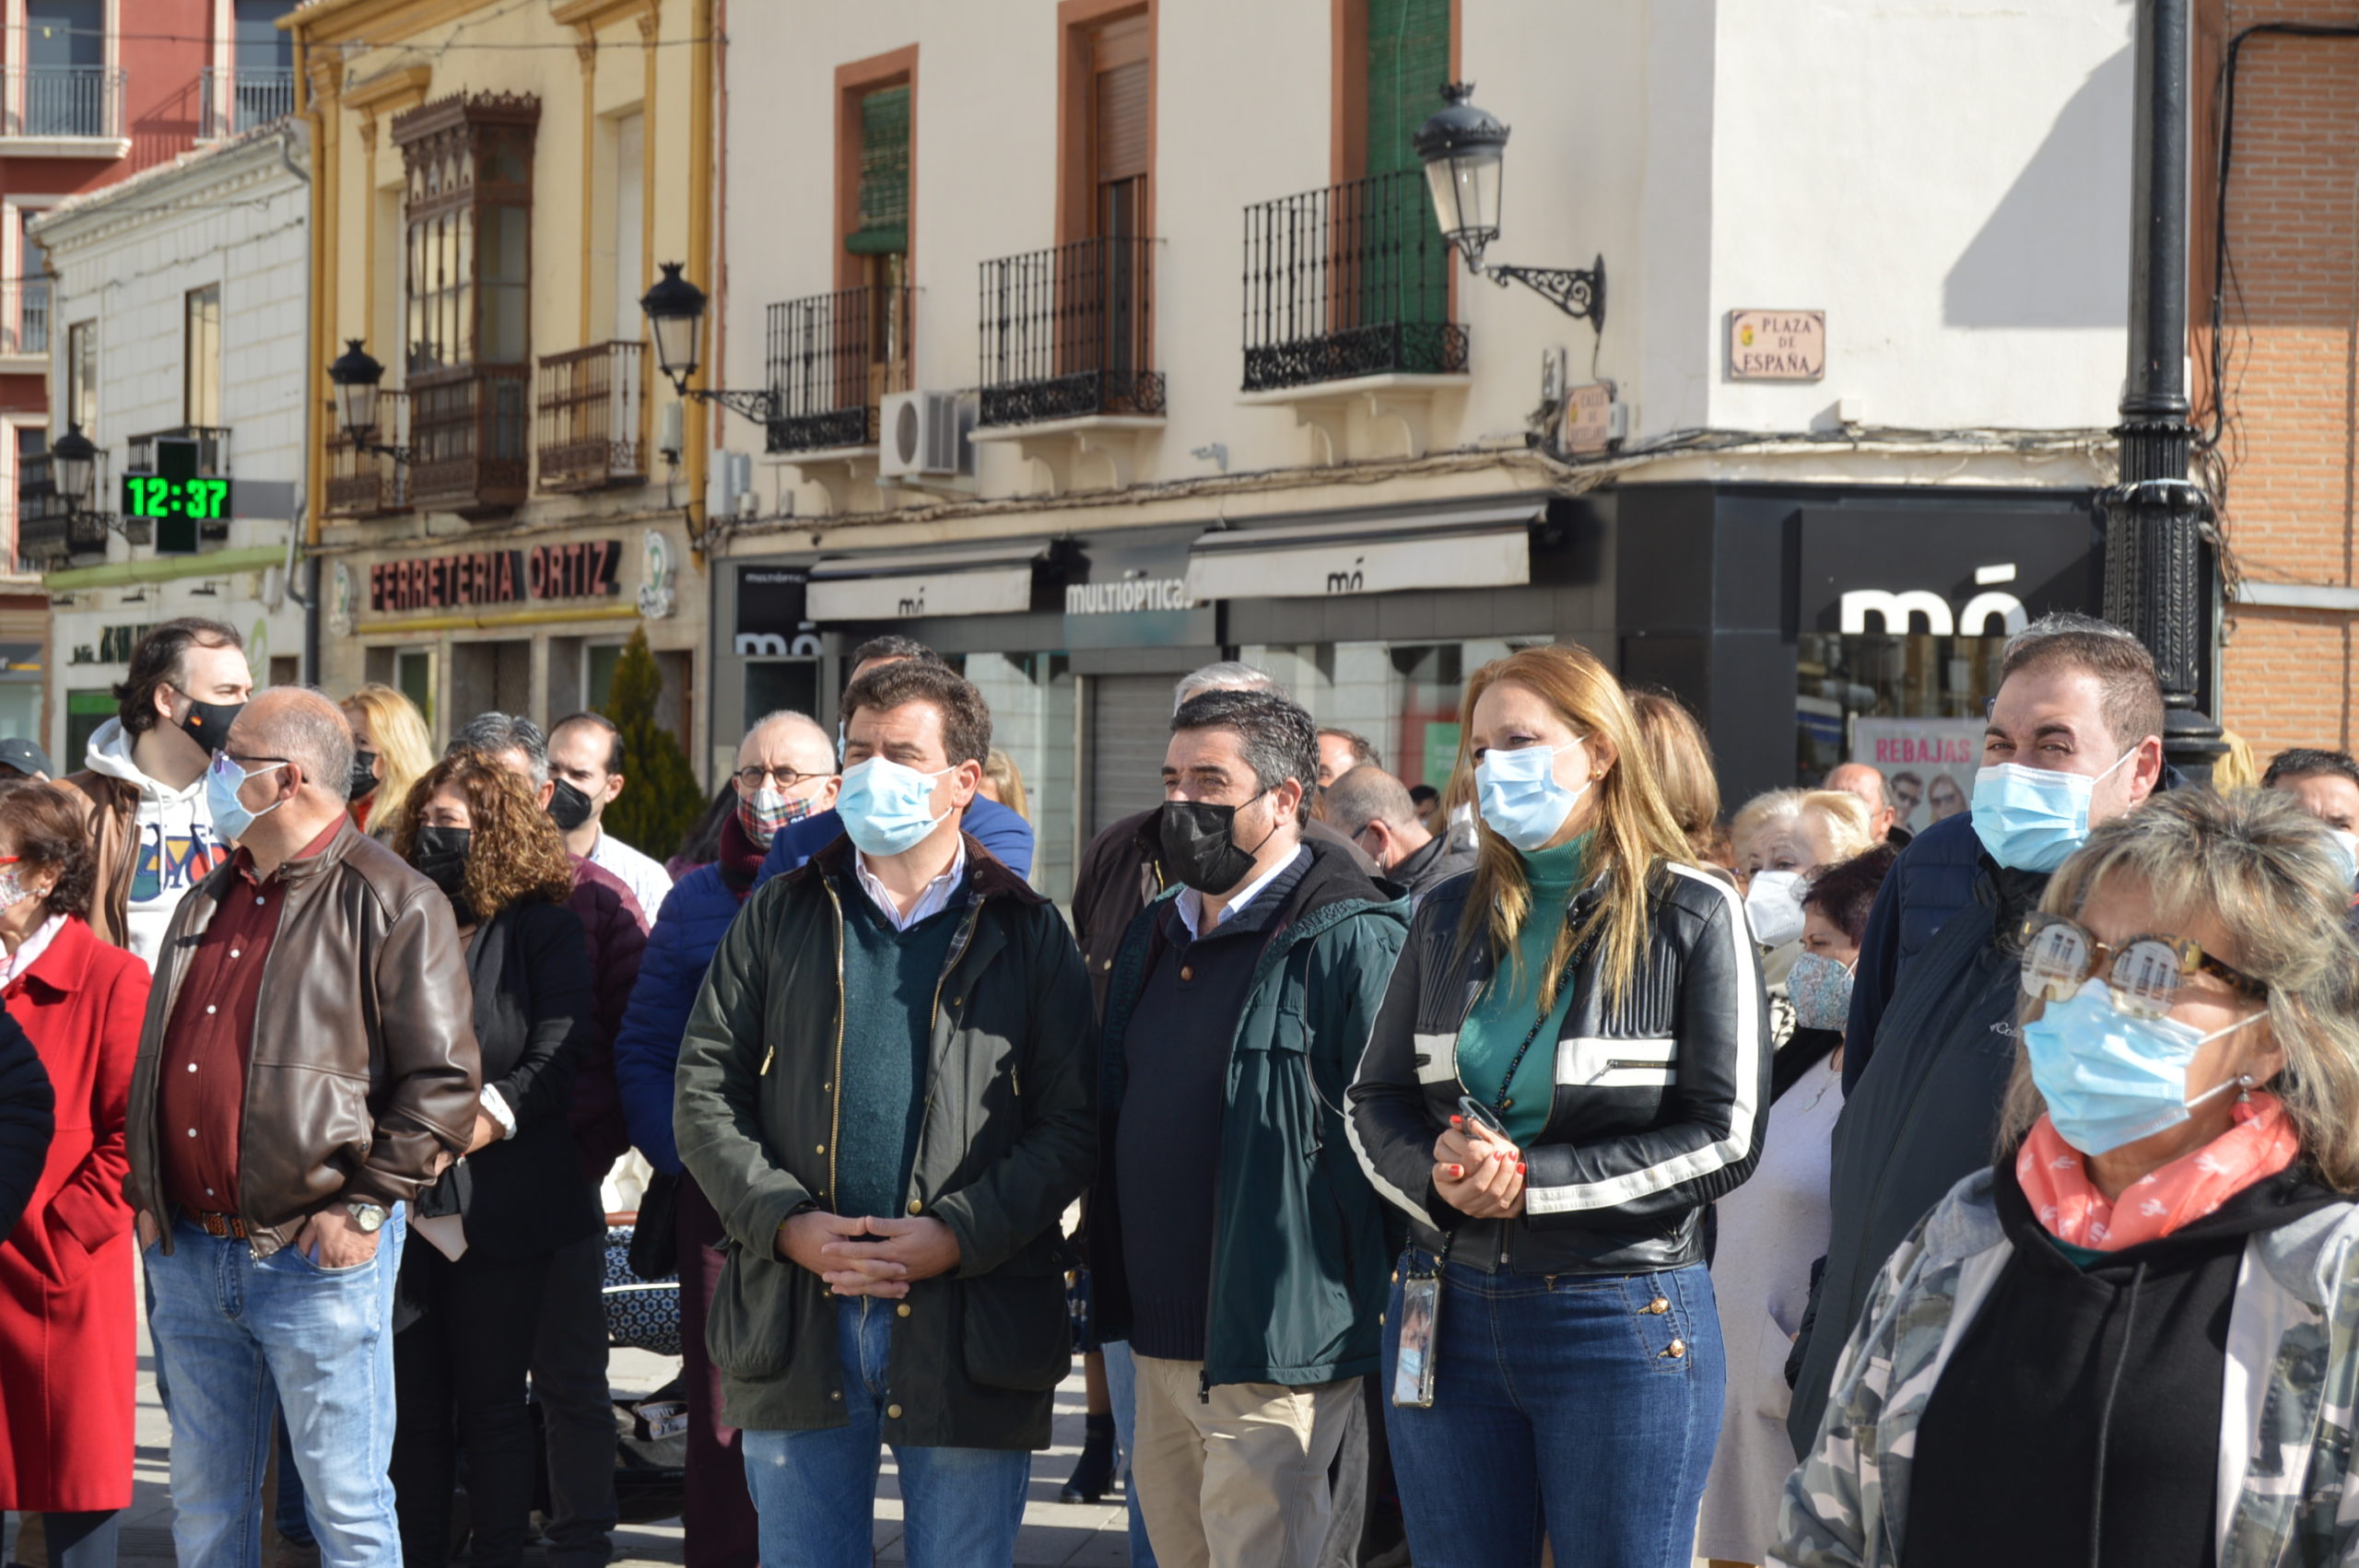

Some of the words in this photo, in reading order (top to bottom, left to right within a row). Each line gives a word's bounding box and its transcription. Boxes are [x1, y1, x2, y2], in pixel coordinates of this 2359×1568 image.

[1762, 317, 1813, 334] PLAZA
[1778, 336, 1796, 349] DE
[1743, 352, 1810, 373] ESPAÑA
[127, 477, 228, 519] 12:37
[370, 549, 519, 612] FERRETERIA
[529, 541, 613, 600] ORTIZ
[1875, 737, 1973, 765] REBAJAS
